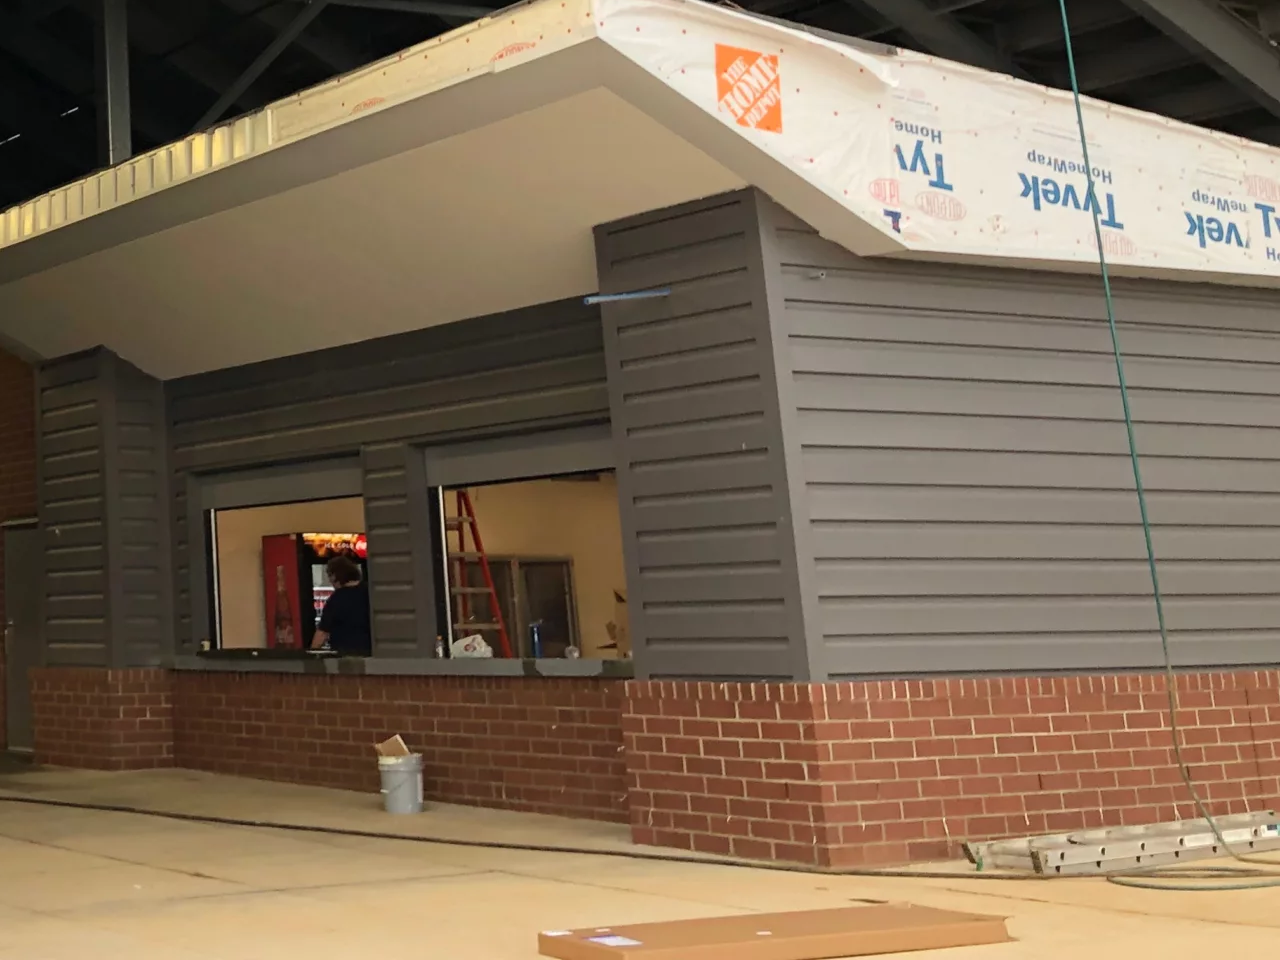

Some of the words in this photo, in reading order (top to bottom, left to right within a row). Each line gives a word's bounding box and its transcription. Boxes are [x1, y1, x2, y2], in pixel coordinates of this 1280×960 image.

[719, 55, 778, 118] HOME
[722, 55, 748, 86] THE
[744, 83, 781, 128] DEPOT
[894, 120, 942, 144] Home
[1017, 172, 1124, 230] Tyvek
